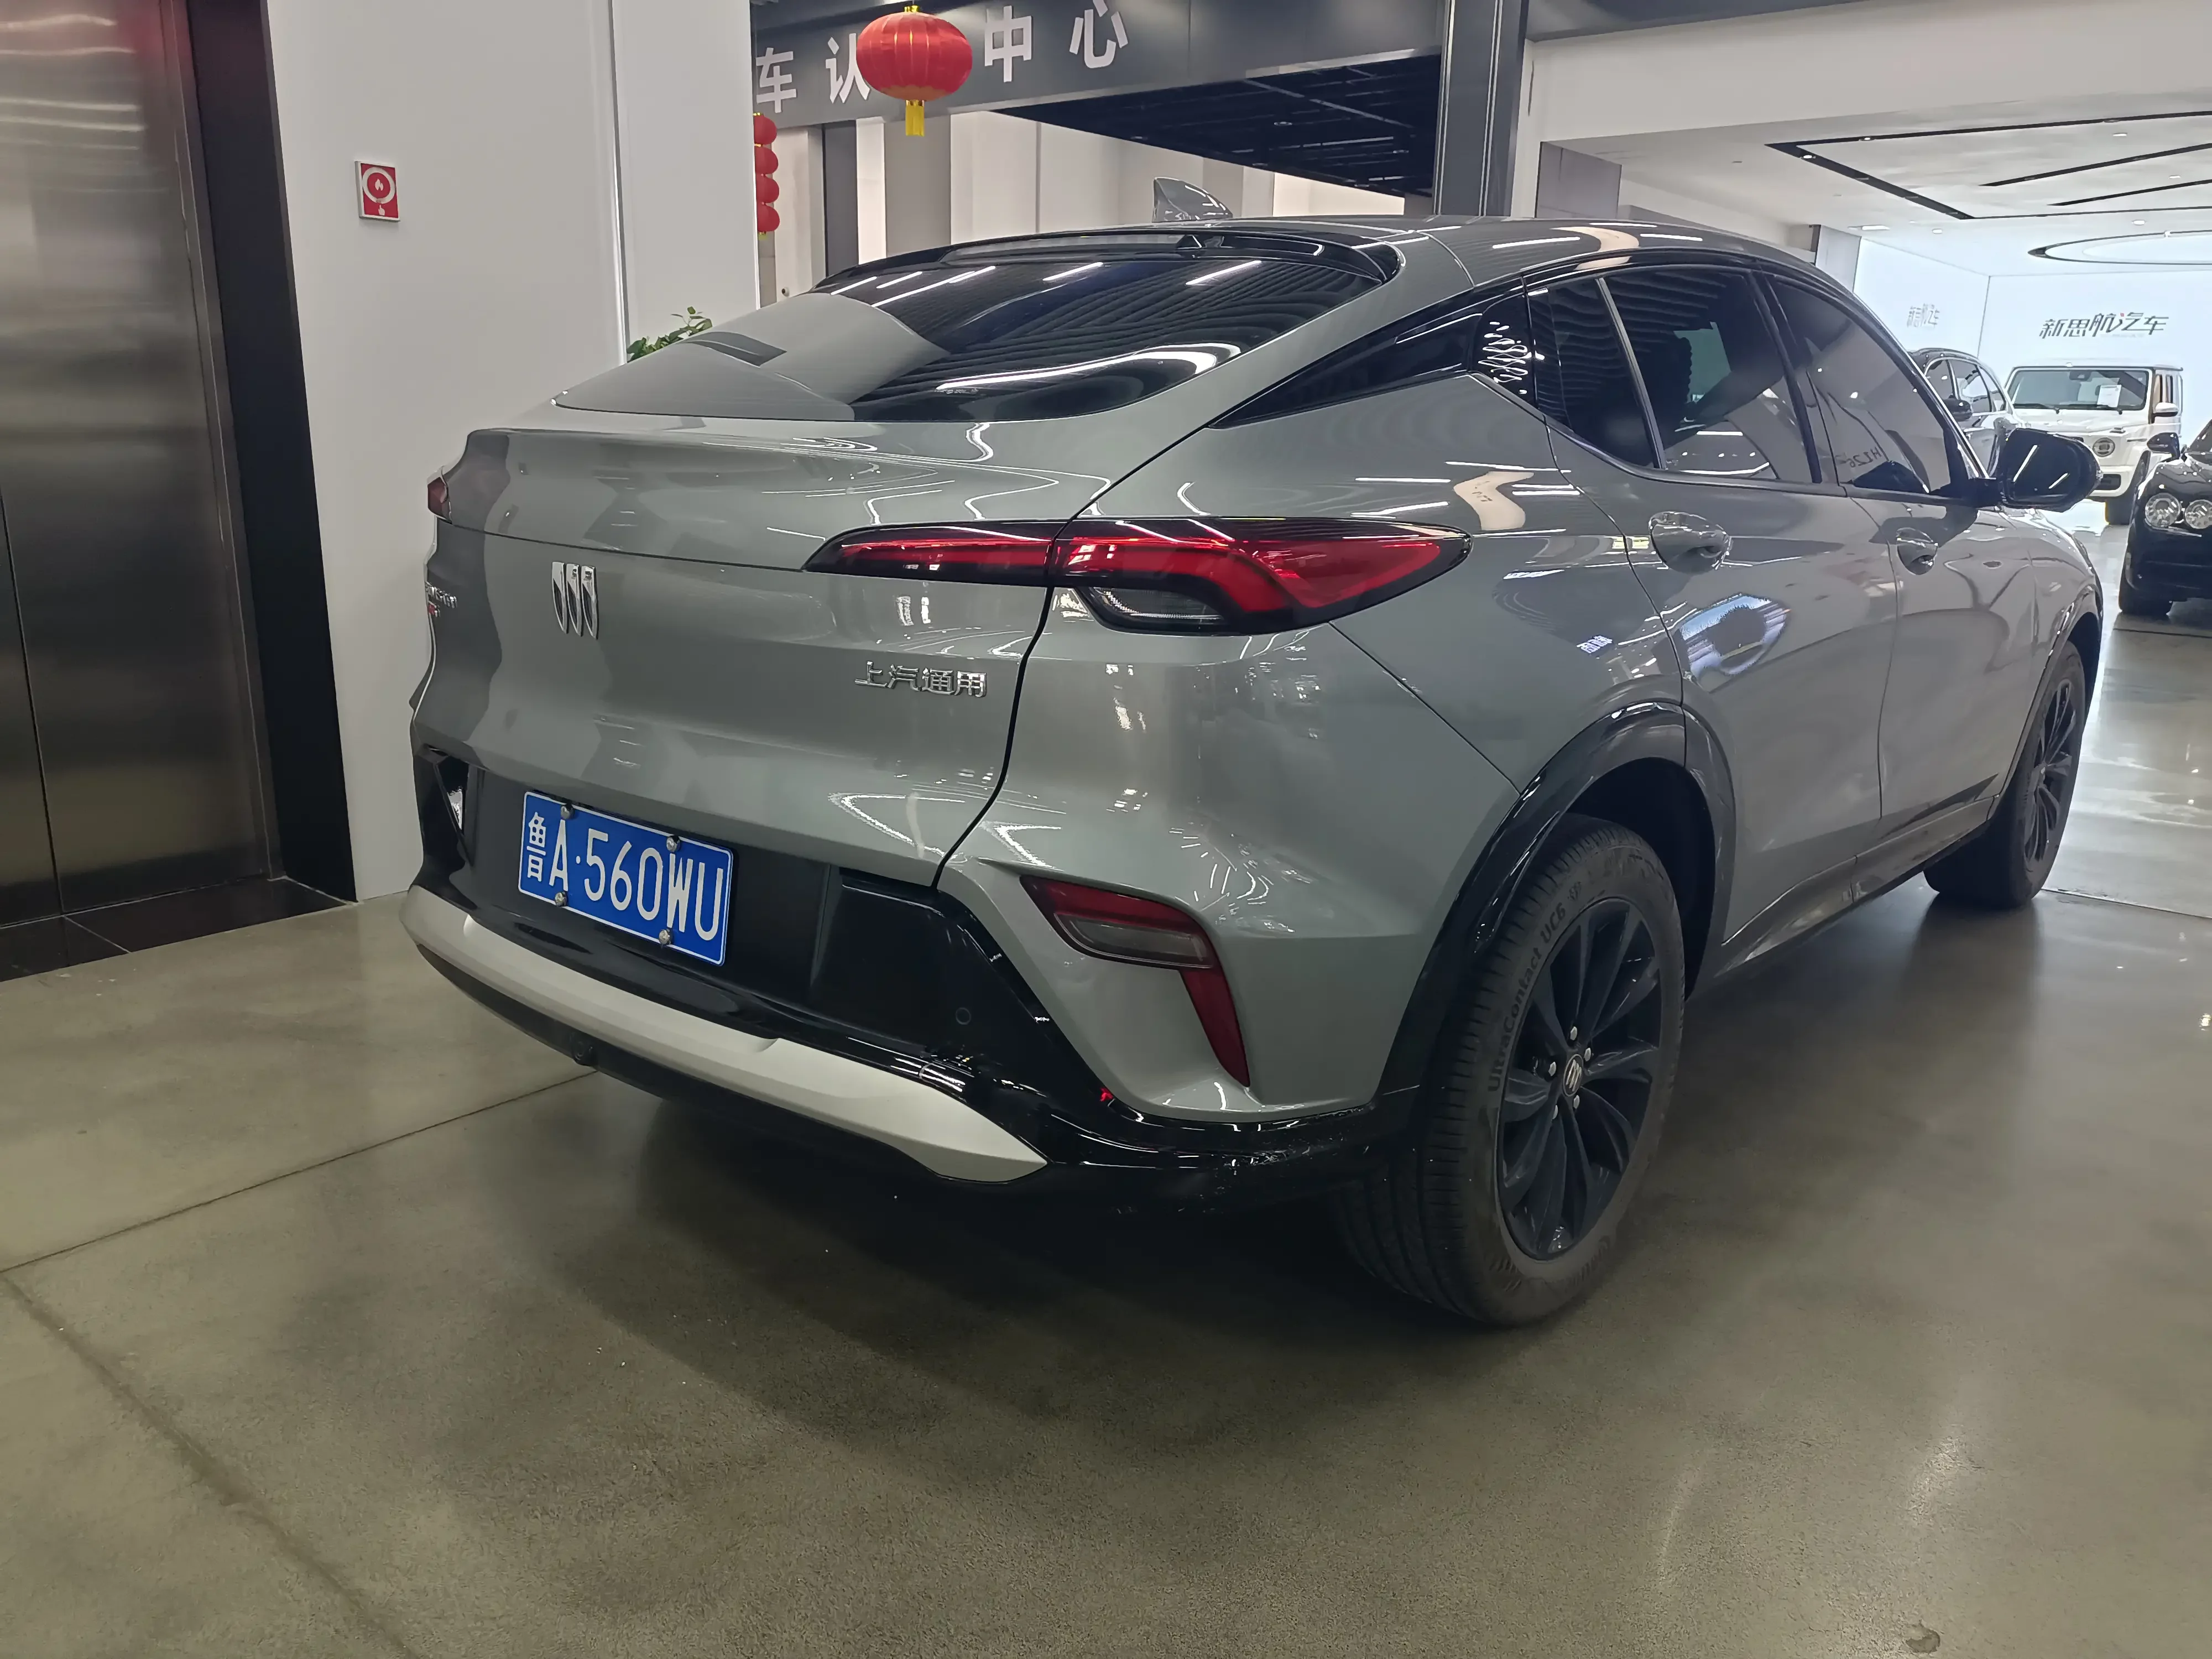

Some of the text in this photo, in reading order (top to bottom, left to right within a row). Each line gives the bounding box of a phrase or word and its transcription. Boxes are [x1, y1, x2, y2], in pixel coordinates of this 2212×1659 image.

[754, 0, 1129, 113] 车认中心
[854, 661, 987, 697] 上汽通用
[1488, 902, 1567, 1093] UltraContact UC6
